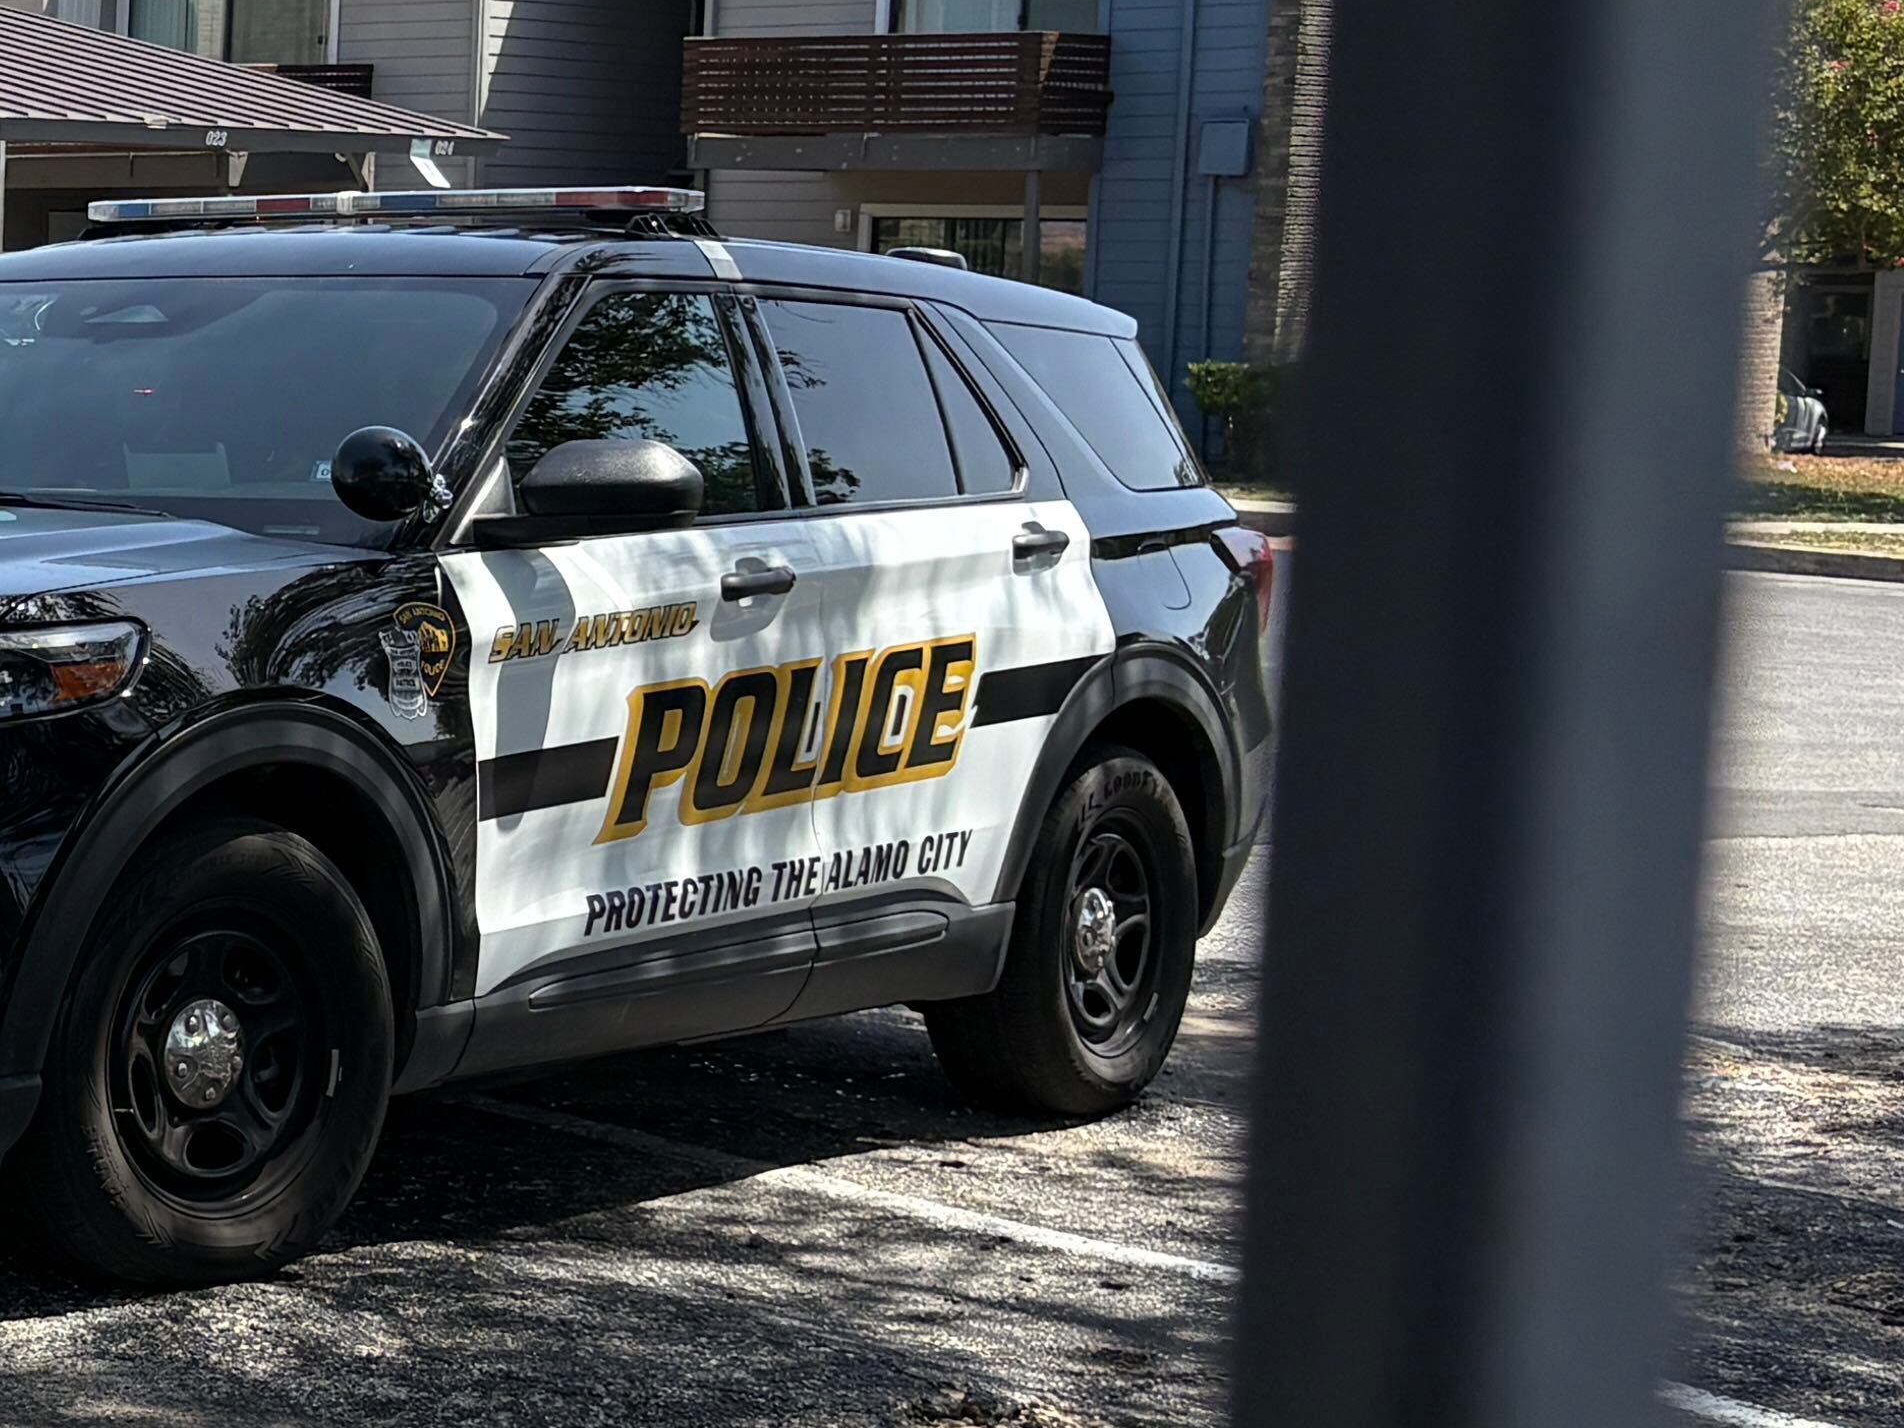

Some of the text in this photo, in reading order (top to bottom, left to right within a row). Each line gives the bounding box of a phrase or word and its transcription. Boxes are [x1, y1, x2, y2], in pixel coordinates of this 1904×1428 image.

[488, 601, 700, 664] SAN ANTONIO
[592, 633, 976, 846] POLICE
[583, 829, 974, 937] PROTECTING THE ALAMO CITY
